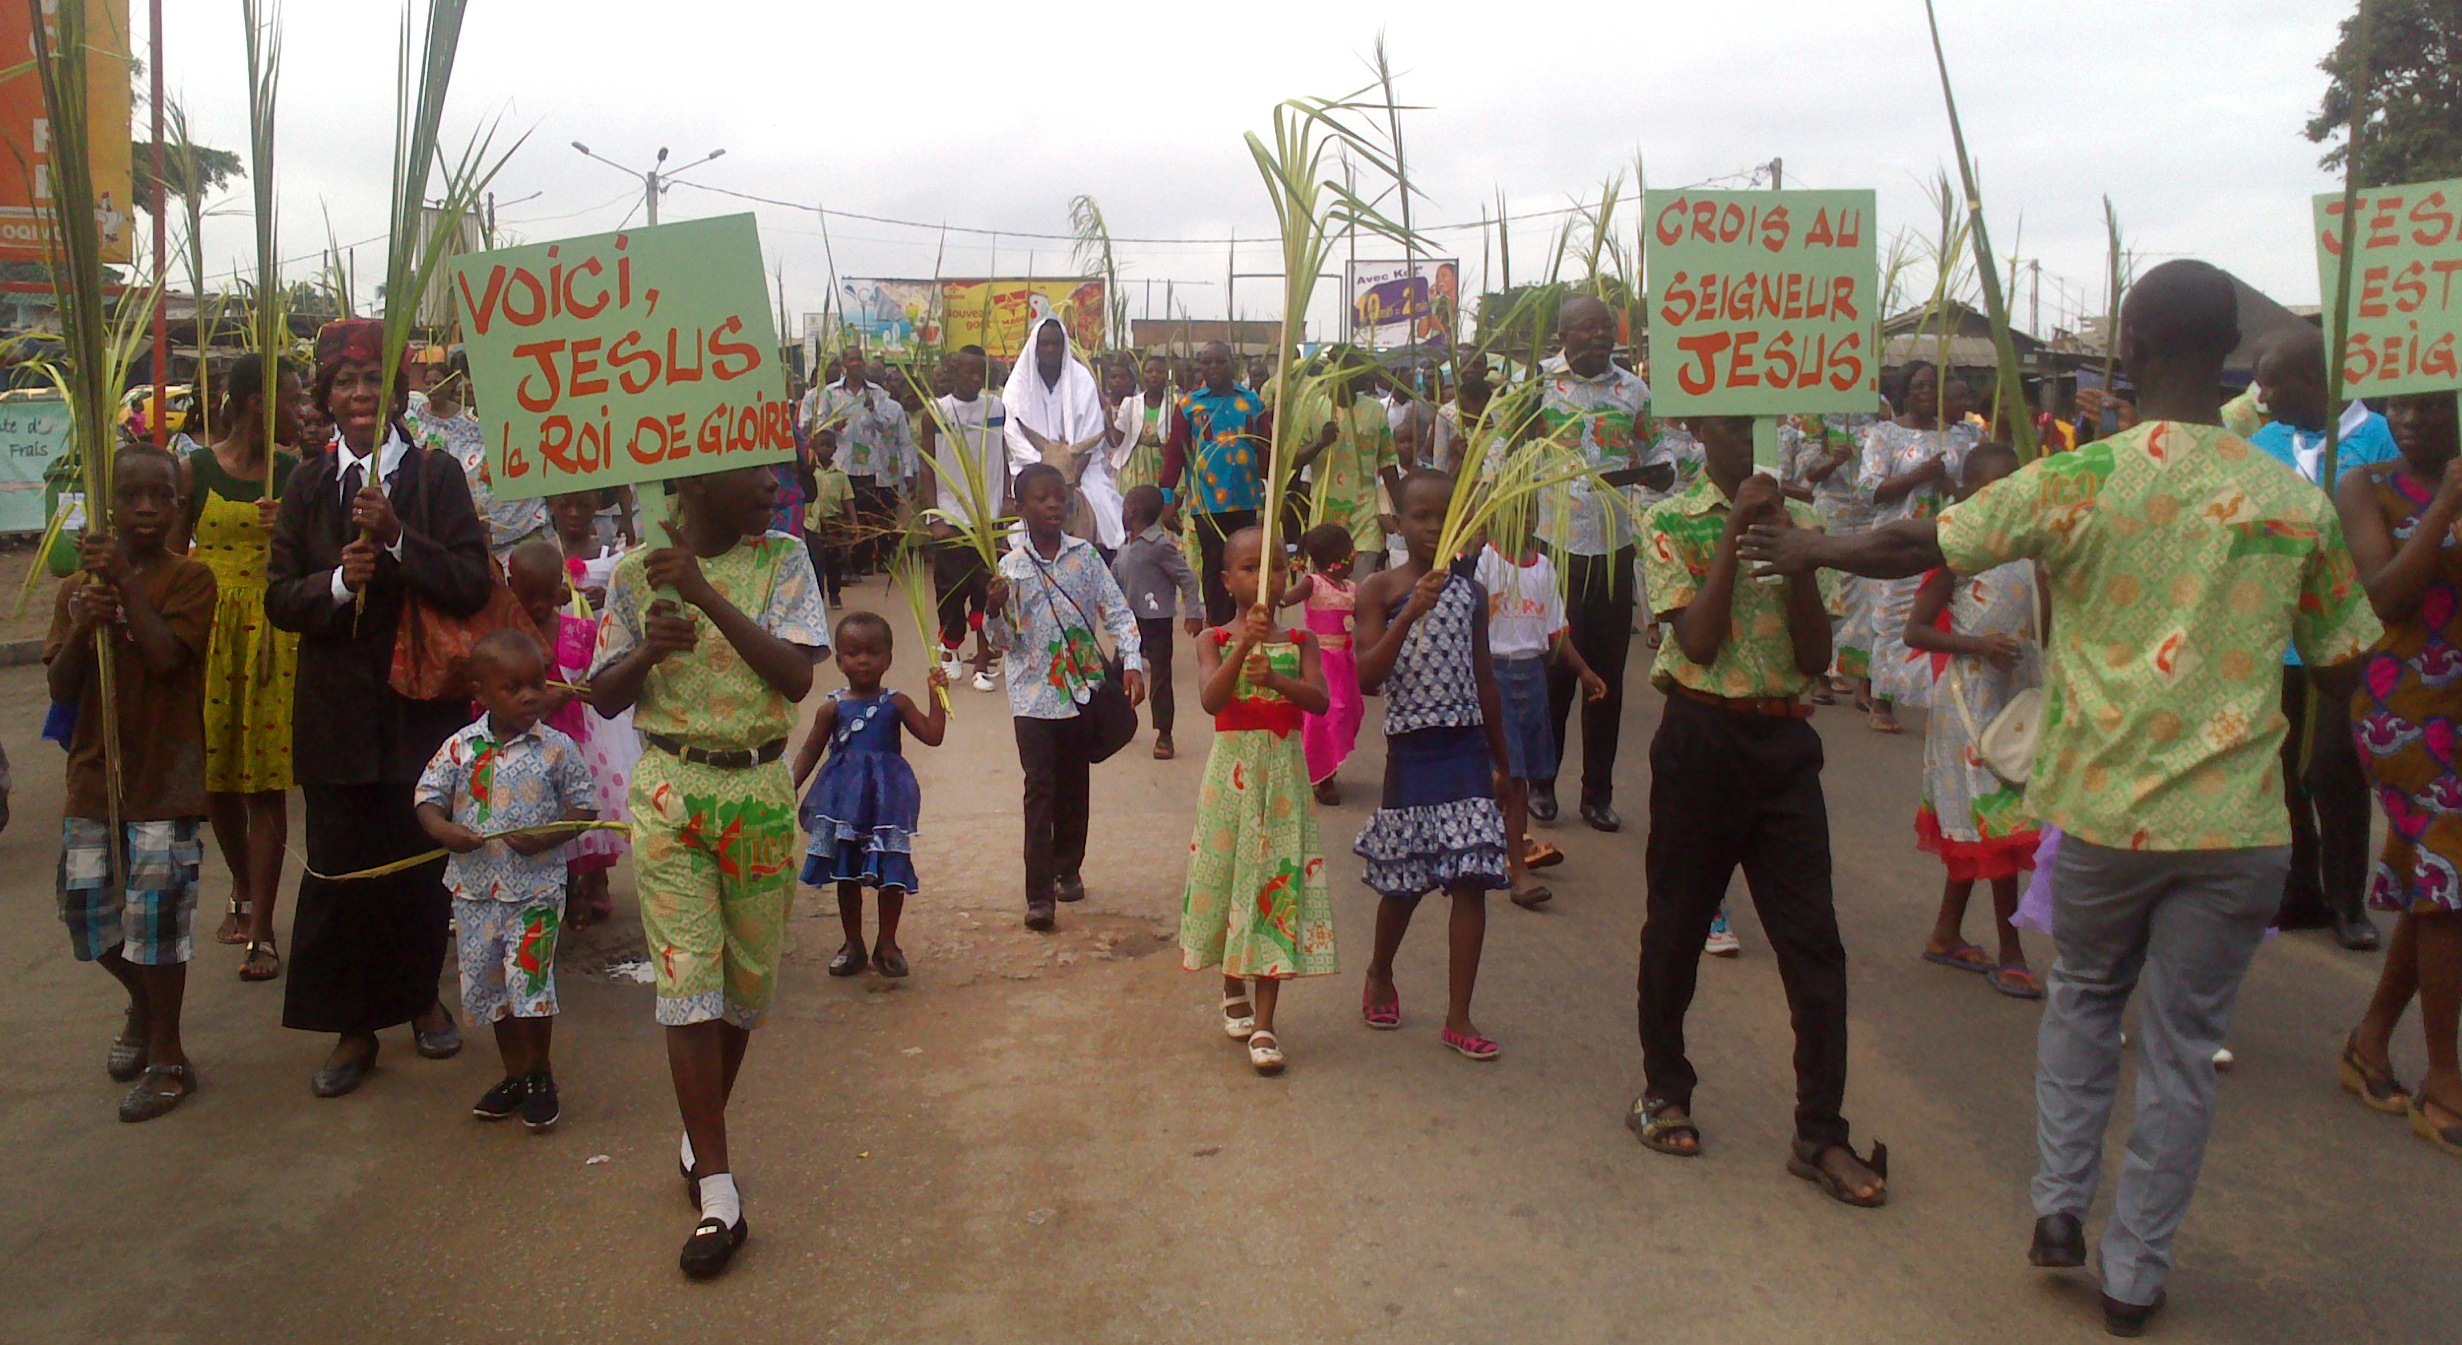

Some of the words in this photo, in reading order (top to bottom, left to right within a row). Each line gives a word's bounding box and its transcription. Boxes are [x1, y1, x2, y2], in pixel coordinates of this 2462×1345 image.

[1655, 196, 1791, 254] CROIS
[1804, 206, 1861, 249] AU
[2321, 190, 2462, 256] JES
[458, 233, 660, 336] VOICI,
[1356, 292, 1380, 322] 10
[1357, 274, 1388, 285] Avec
[1660, 270, 1858, 327] SEIGNEUR
[2357, 260, 2462, 319] EST
[512, 314, 761, 413] JESUS
[2343, 319, 2462, 386] SEIG
[9, 441, 49, 458] Frais
[539, 404, 611, 479] ROI
[626, 412, 691, 465] DE
[697, 390, 794, 456] GLOIRE
